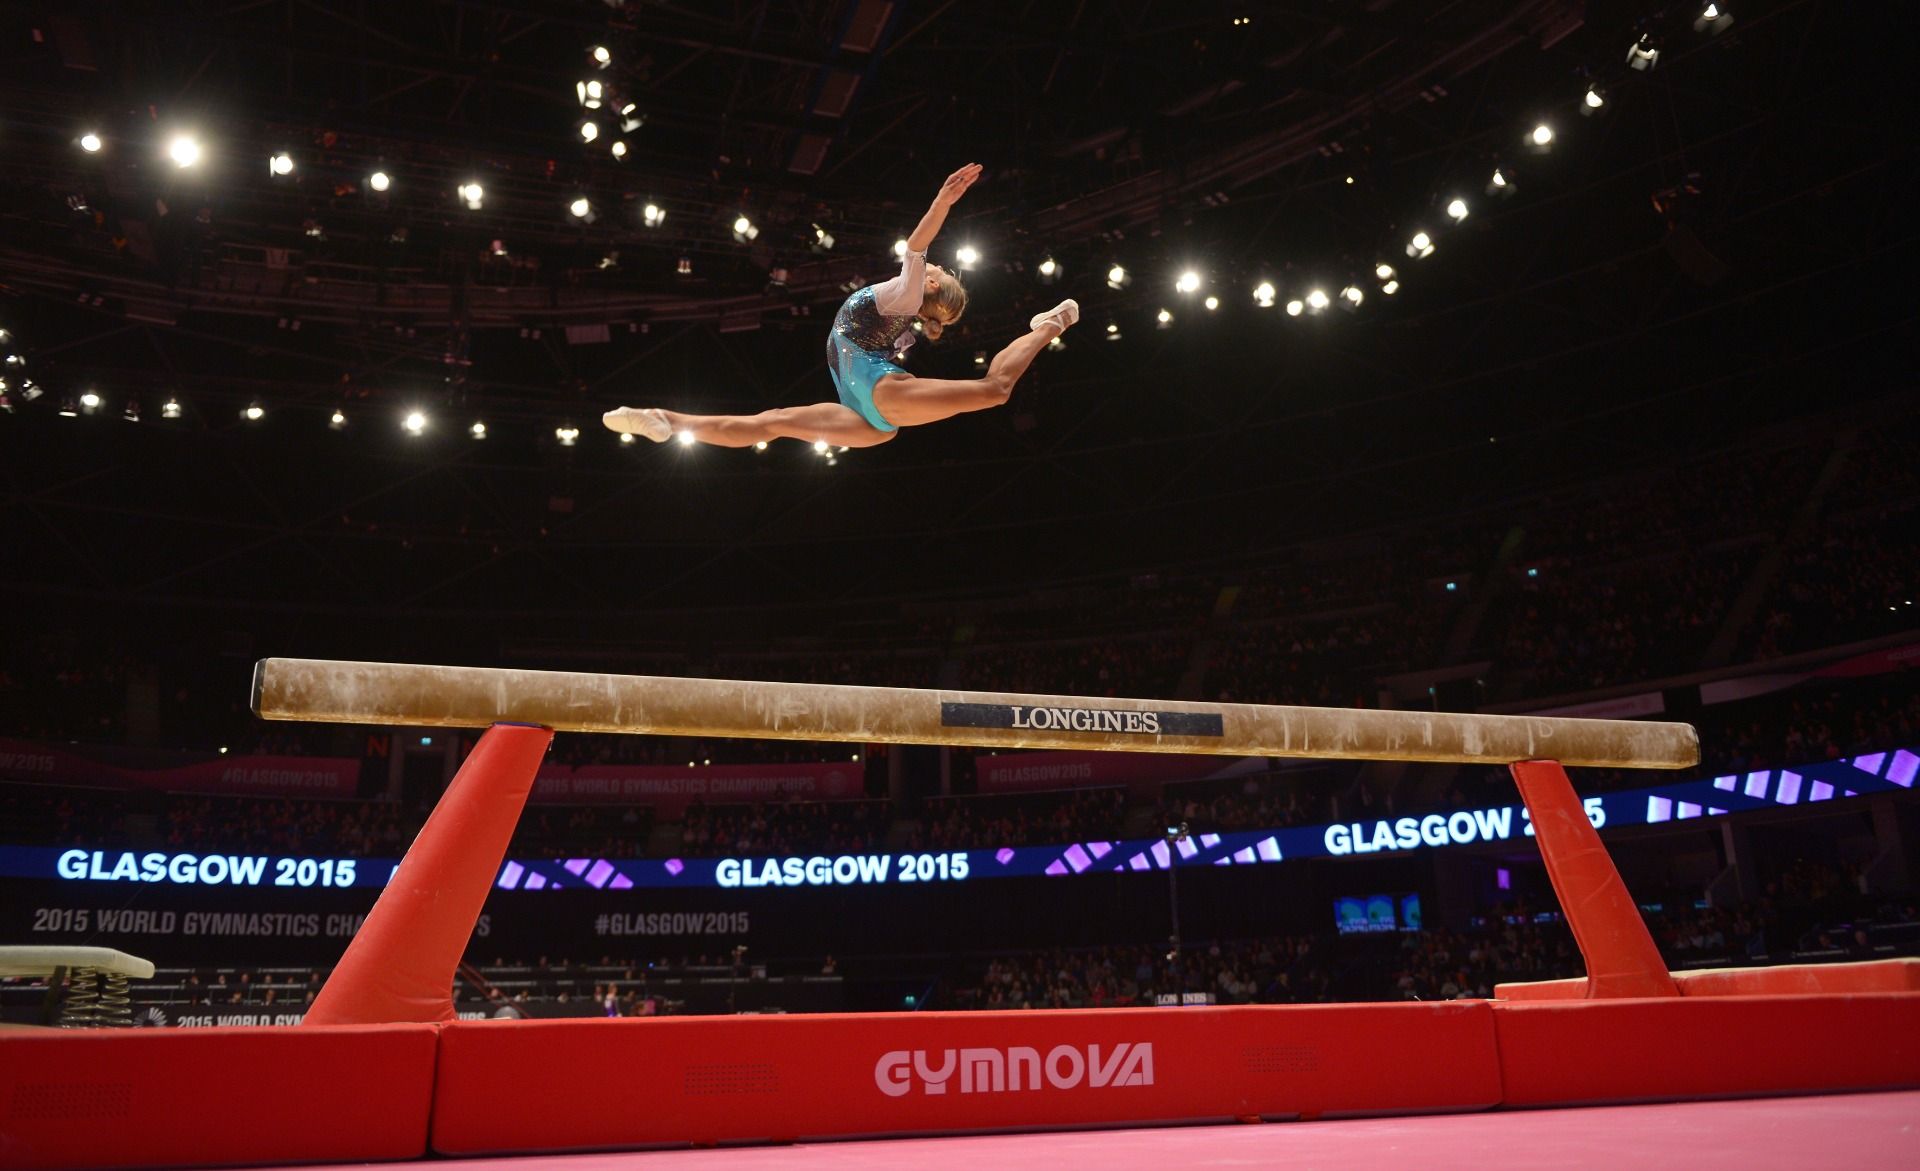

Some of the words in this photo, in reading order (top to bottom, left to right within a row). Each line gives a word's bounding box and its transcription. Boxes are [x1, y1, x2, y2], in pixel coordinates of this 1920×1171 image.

[1011, 706, 1160, 734] LONGINES
[222, 768, 338, 788] #GLASGOW2015
[538, 778, 569, 793] 2015
[572, 778, 620, 793] WORLD
[624, 778, 706, 793] GYMNASTICS
[990, 763, 1092, 783] #GLASGOW2015
[1323, 806, 1513, 856] GLASGOW
[57, 849, 268, 884] GLASGOW
[274, 858, 357, 887] 2015
[715, 855, 891, 888] GLASGOW
[898, 852, 969, 882] 2015
[32, 908, 89, 932] 2015
[97, 909, 176, 933] WORLD
[183, 912, 320, 936] GYMNASTICS
[595, 911, 749, 935] #GLASGOW2015
[1157, 993, 1207, 1005] LONINES
[874, 1042, 1154, 1097] GYMNOVA
